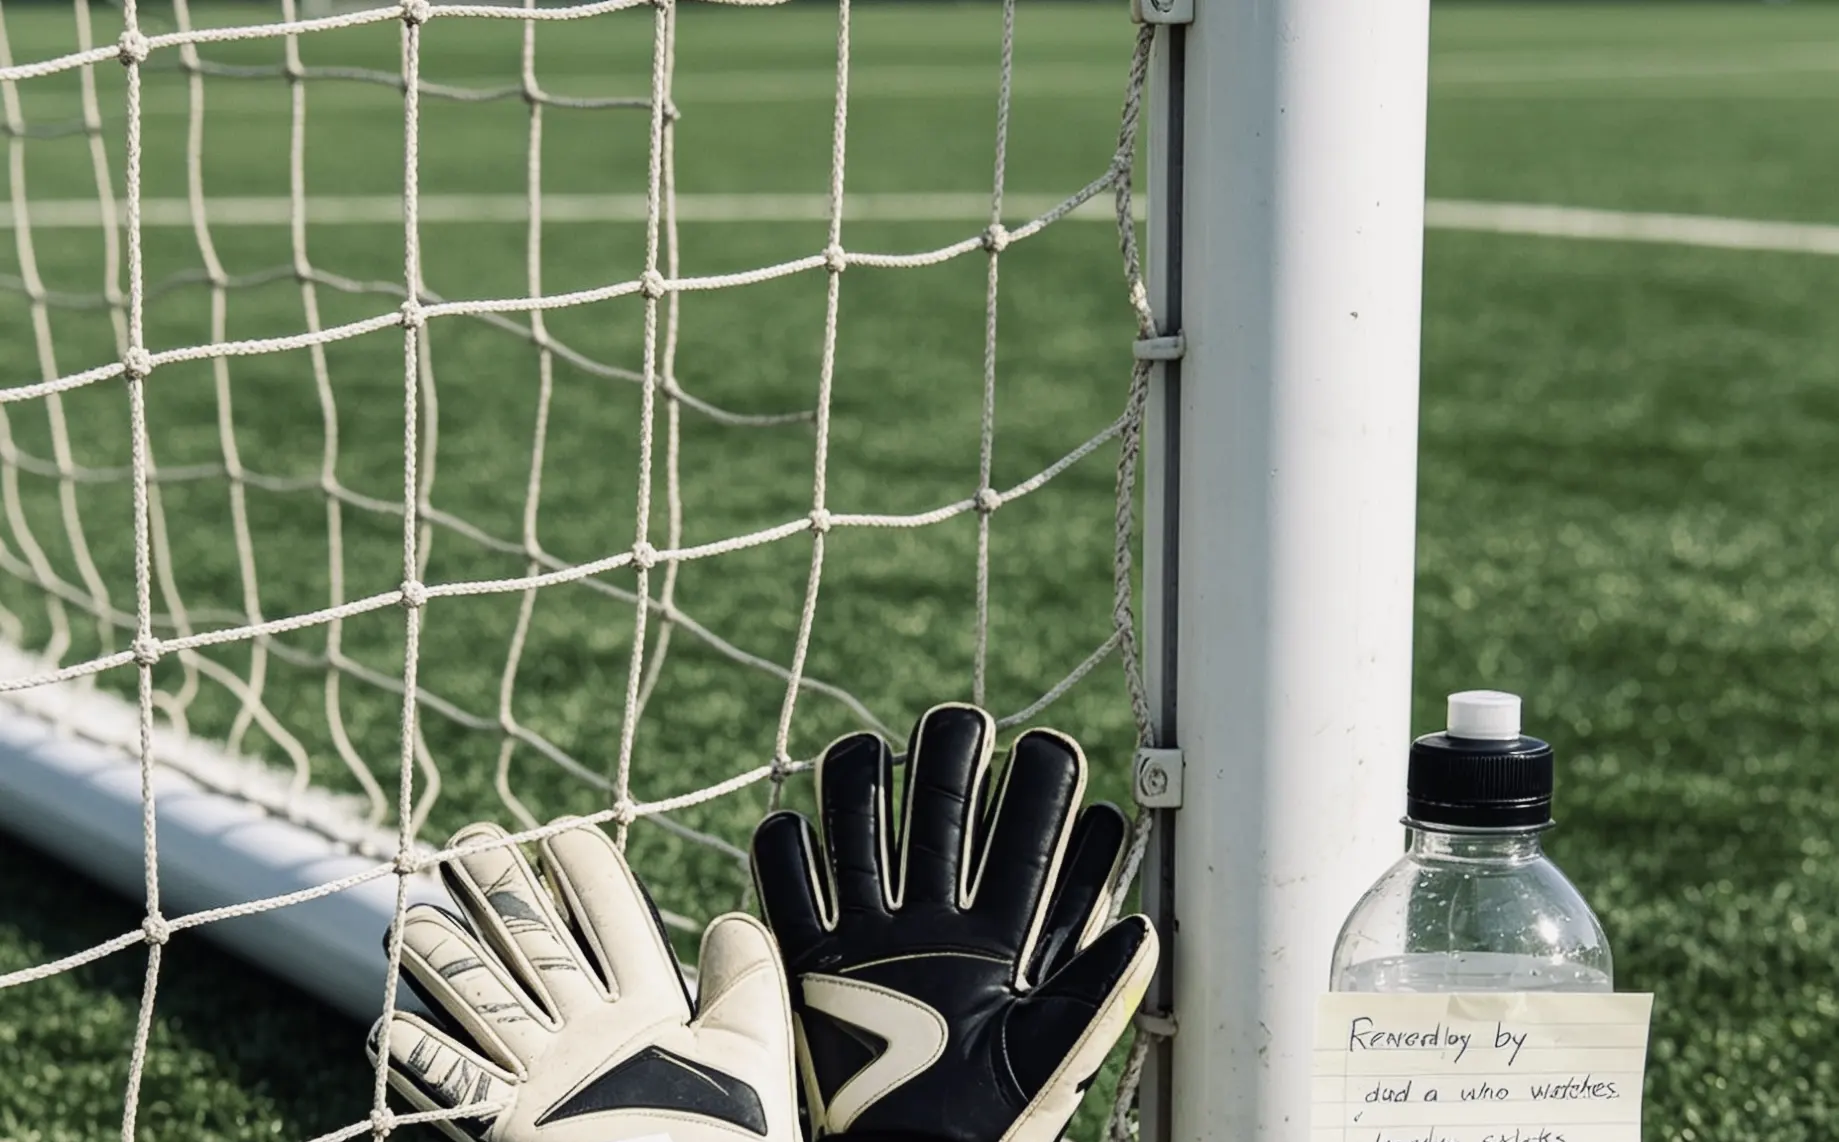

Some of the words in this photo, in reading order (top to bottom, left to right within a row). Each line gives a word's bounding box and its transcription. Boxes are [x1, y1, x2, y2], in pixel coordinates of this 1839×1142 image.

[1494, 1021, 1527, 1066] by
[1424, 1088, 1438, 1102] a
[1461, 1081, 1509, 1101] who
